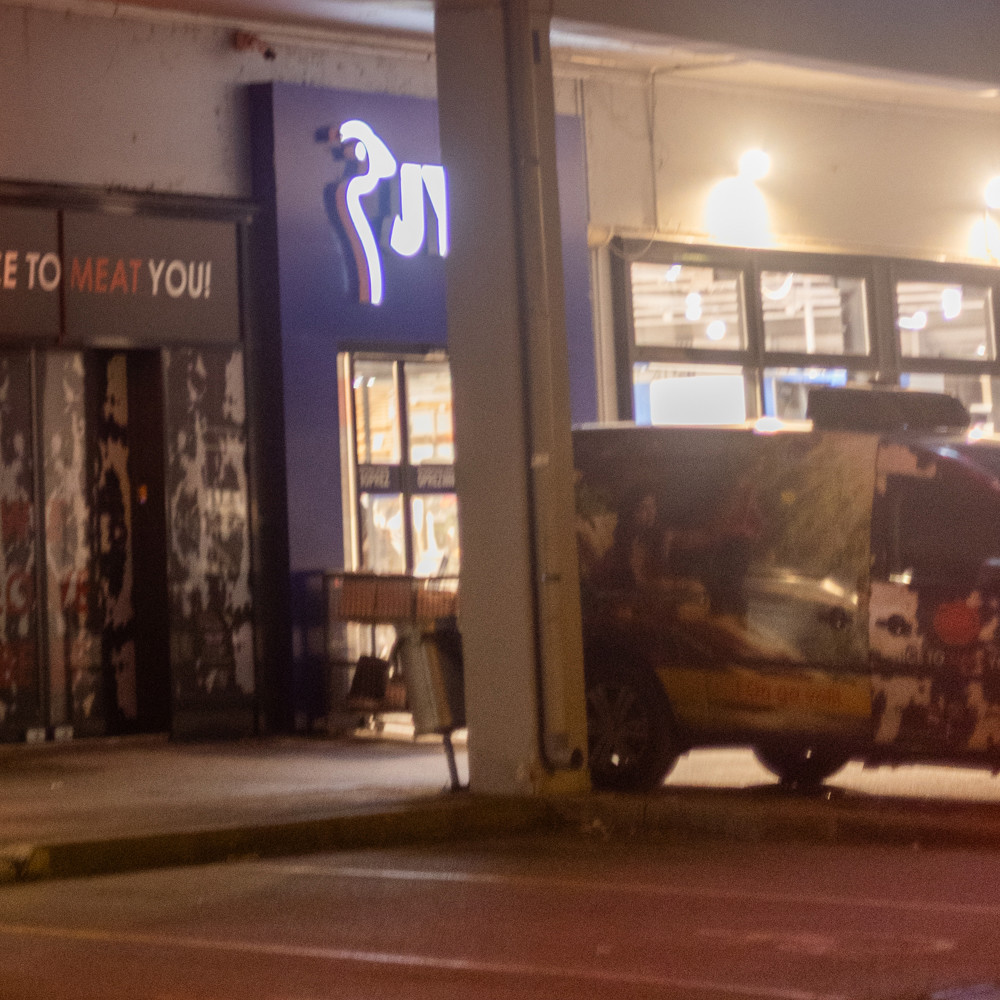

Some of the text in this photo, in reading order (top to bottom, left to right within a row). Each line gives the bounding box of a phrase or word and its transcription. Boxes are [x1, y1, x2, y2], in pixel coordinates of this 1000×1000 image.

[26, 251, 62, 293] TO
[70, 256, 142, 295] MEAT
[149, 259, 212, 300] YOU!
